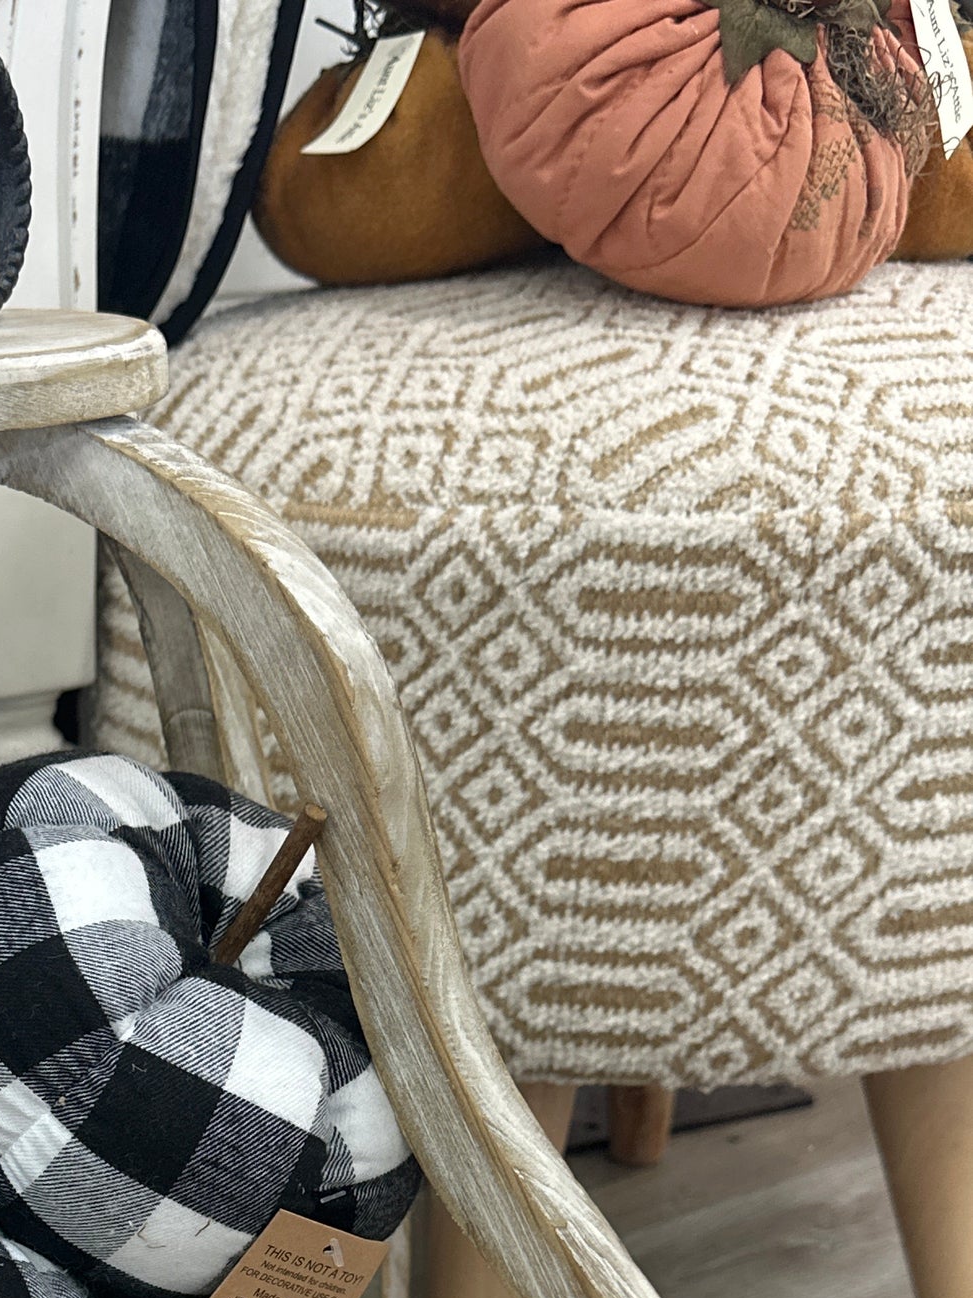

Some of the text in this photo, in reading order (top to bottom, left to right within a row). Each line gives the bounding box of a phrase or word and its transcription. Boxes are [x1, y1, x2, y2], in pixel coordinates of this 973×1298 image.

[926, 0, 941, 38] Aunt
[240, 1266, 261, 1279] FOR
[259, 1272, 313, 1298] DECORATIVE
[260, 1260, 276, 1272] Not
[276, 1265, 308, 1282] intended
[308, 1275, 319, 1286] for
[264, 1244, 364, 1286] THIS IS NOT A TOY!
